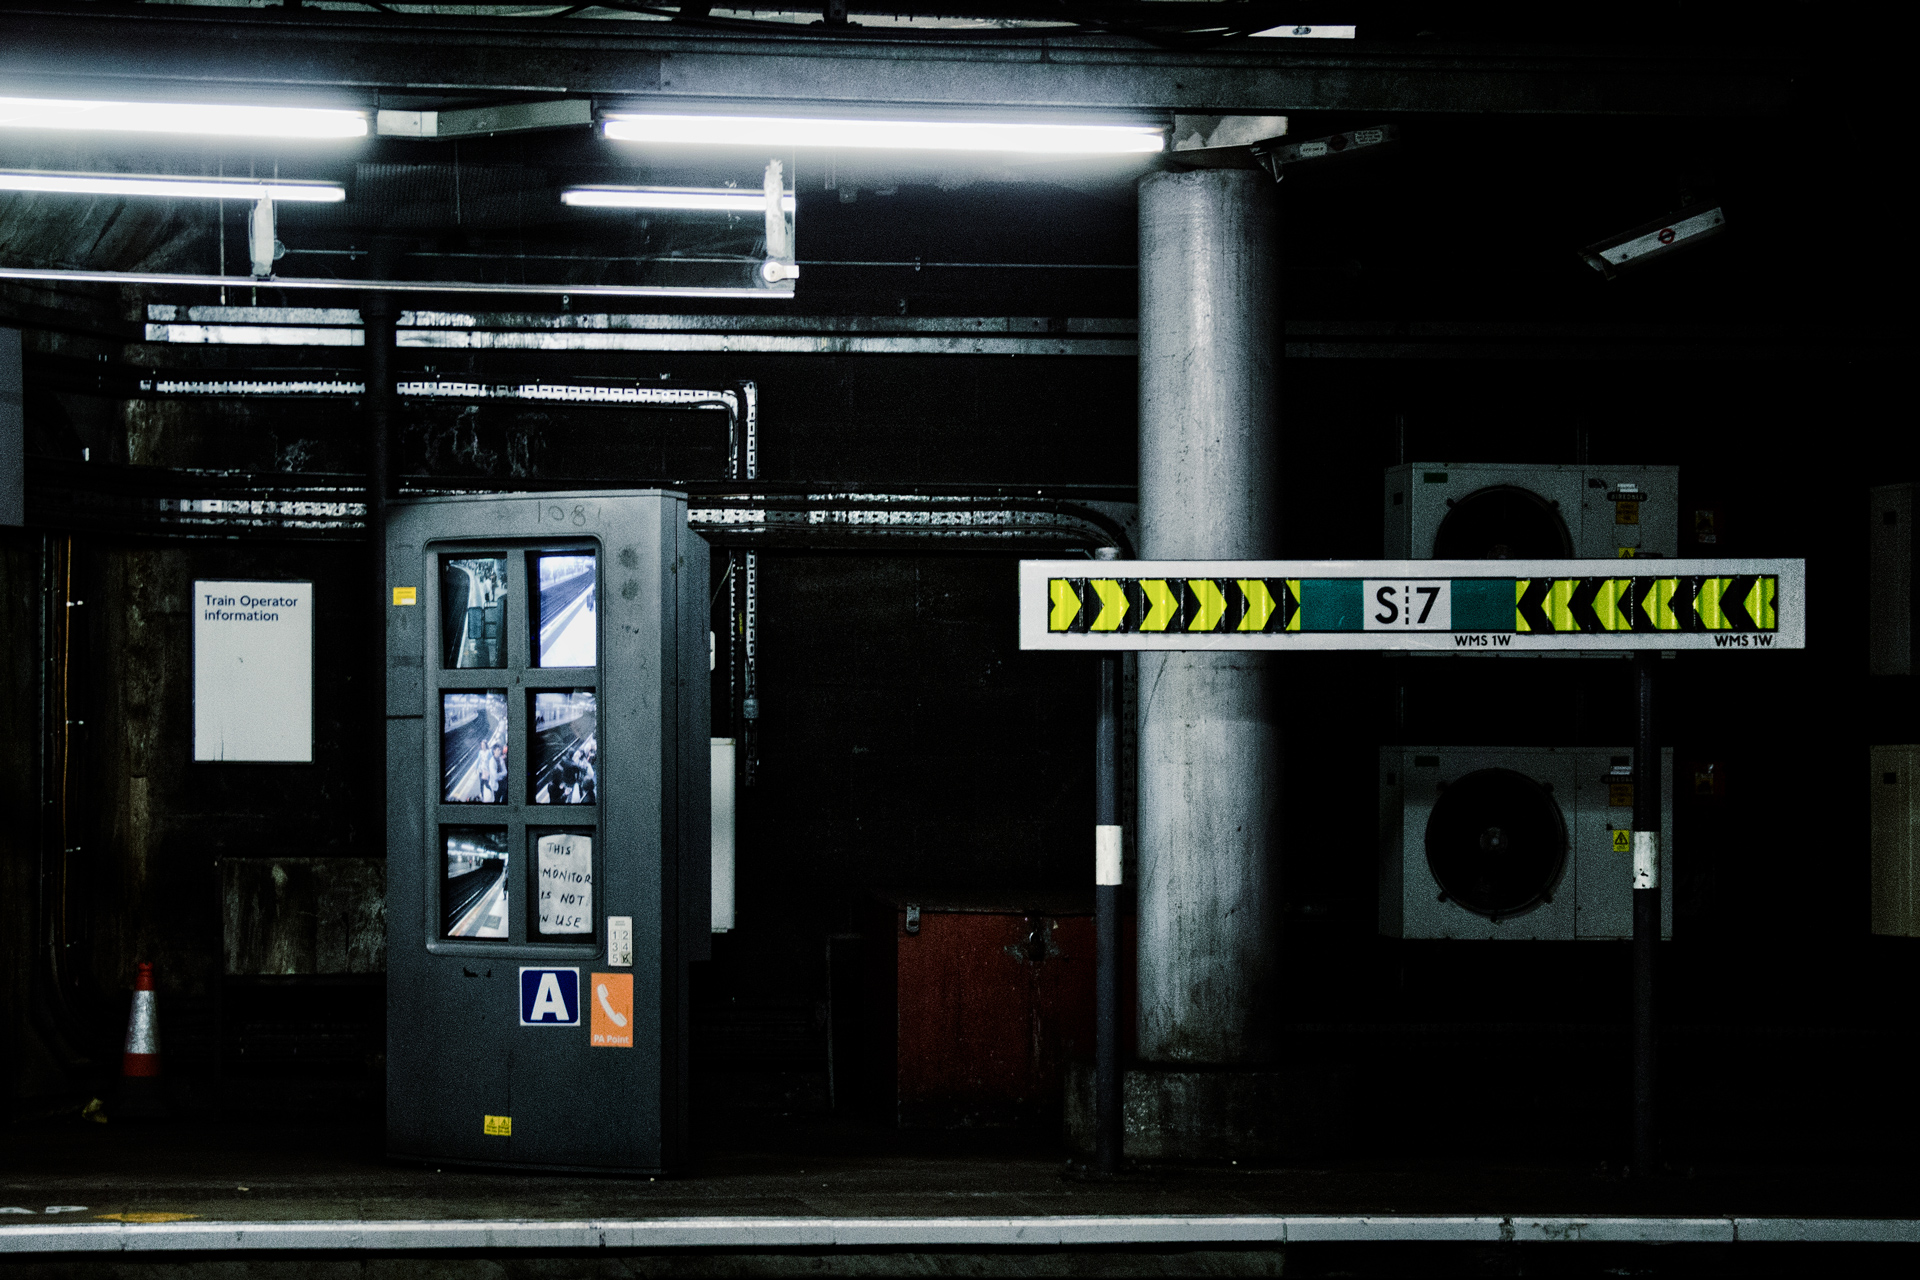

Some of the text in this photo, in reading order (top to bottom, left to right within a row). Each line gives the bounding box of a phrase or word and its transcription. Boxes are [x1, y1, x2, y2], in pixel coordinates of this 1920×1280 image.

[204, 595, 298, 609] Train Operator
[204, 610, 279, 621] information
[1454, 635, 1512, 646] WMS 1W
[1714, 634, 1773, 647] WMS 1W
[547, 842, 571, 855] THIS
[542, 867, 592, 884] MONITOR
[541, 891, 585, 906] IS NOT
[555, 915, 581, 928] USE
[622, 931, 629, 940] 2
[612, 942, 629, 951] 3 4
[612, 954, 619, 963] 5
[530, 973, 570, 1021] A
[593, 1034, 630, 1044] PA Point
